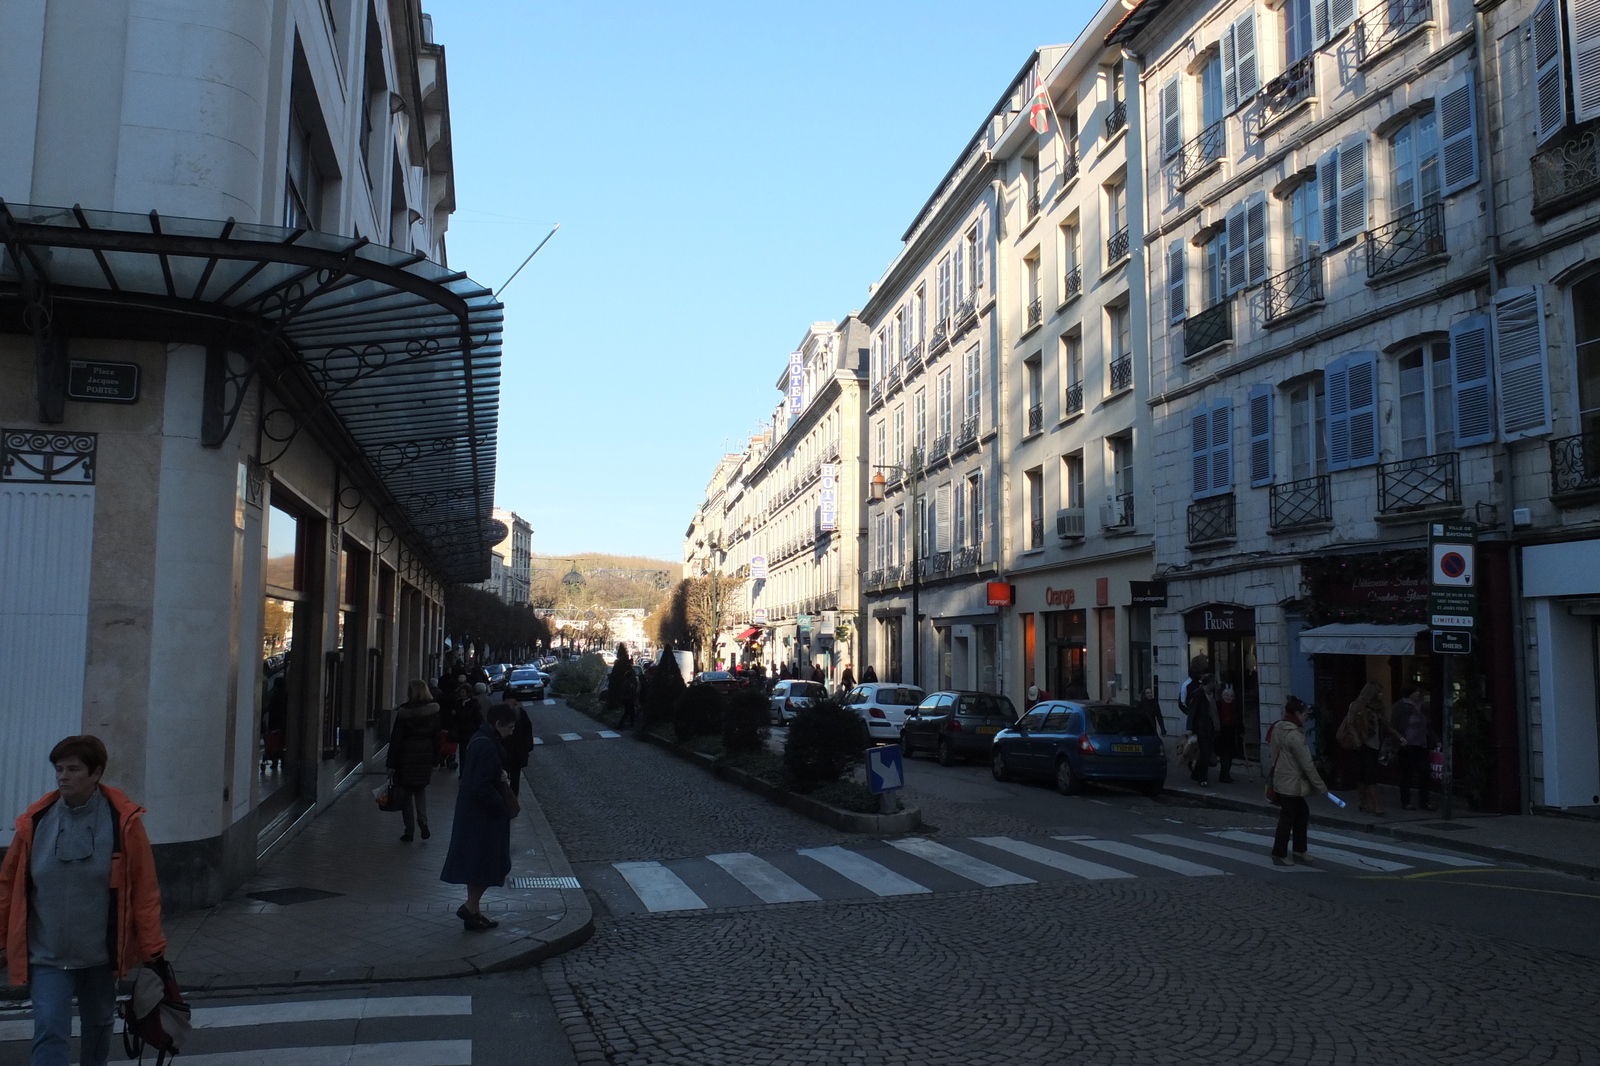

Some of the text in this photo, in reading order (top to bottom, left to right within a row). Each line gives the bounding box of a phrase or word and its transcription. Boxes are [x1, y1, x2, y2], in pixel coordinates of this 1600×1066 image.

[93, 367, 115, 375] Place
[87, 376, 119, 385] Jacques
[791, 354, 802, 408] HOTEL
[86, 386, 119, 394] PORTES
[822, 466, 834, 524] HOTEL
[1393, 573, 1418, 586] Salon
[1046, 586, 1075, 609] Orange
[1204, 610, 1234, 629] PRUNE
